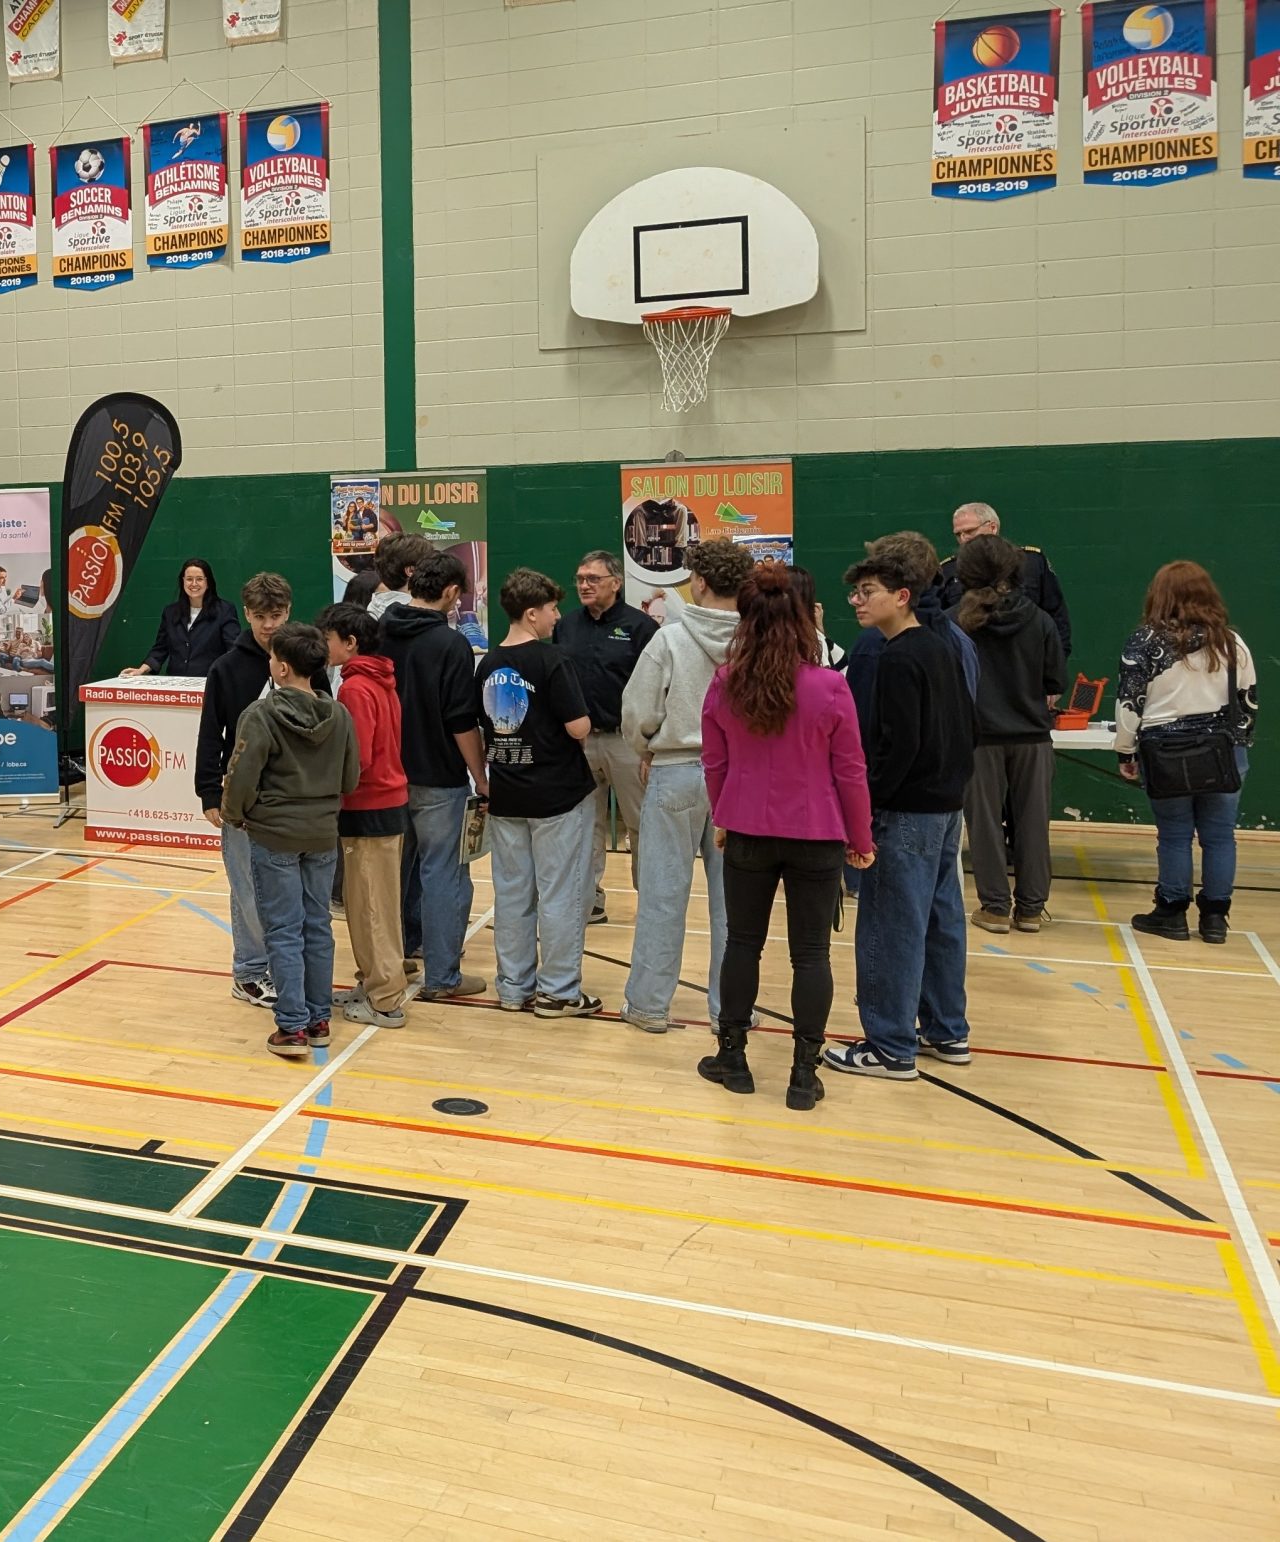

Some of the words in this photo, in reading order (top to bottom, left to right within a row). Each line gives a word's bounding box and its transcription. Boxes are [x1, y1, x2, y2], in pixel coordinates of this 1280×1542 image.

[1096, 55, 1203, 90] VOLLEYBALL
[945, 73, 1048, 106] BASKETBALL
[1102, 76, 1197, 101] JUVÉNILES
[1129, 91, 1162, 100] DIVISION
[950, 93, 1040, 116] JUVÉNILES
[1109, 115, 1181, 135] Sportive
[1120, 113, 1145, 122] Ligue
[956, 132, 1024, 149] Sportive
[967, 128, 991, 137] Ligue
[1122, 127, 1179, 139] interscolaire
[968, 143, 1022, 153] interscolaire
[1088, 136, 1213, 167] CHAMPIONNES
[154, 161, 220, 191] ATHLÉTISME
[249, 157, 320, 183] VOLLEYBALL
[936, 153, 1053, 180] CHAMPIONNES
[1112, 165, 1187, 182] 2018-2019
[155, 180, 220, 200] BENJAMINS
[247, 174, 323, 196] BENJAMINES
[958, 180, 1029, 194] 2018-2019
[70, 187, 112, 208] SOCCER
[61, 204, 122, 223] BENJAMINS
[163, 211, 208, 226] Sportive
[258, 206, 306, 221] Sportive
[68, 235, 110, 249] Sportive
[153, 228, 223, 252] CHAMPIONS
[244, 223, 328, 247] CHAMPIONNES
[59, 252, 126, 273] CHAMPIONS
[166, 251, 213, 264] 2018-2019
[260, 247, 311, 259] 2018-2019
[70, 273, 116, 285] 2018-2019
[96, 419, 129, 483] 100,5
[115, 432, 148, 495] 103,9
[134, 445, 170, 508] 105,5
[631, 475, 688, 498] SALON
[694, 474, 718, 497] DU
[724, 472, 783, 496] LOISIR
[398, 484, 420, 506] DU
[424, 481, 479, 505] LOISIR
[102, 502, 126, 531] FM
[86, 689, 113, 700] Radio
[117, 690, 203, 704] Bellechasse-Etch
[165, 751, 186, 770] FM
[134, 810, 194, 822] 418.625-3737
[96, 829, 221, 848] www.passion-fm.co
